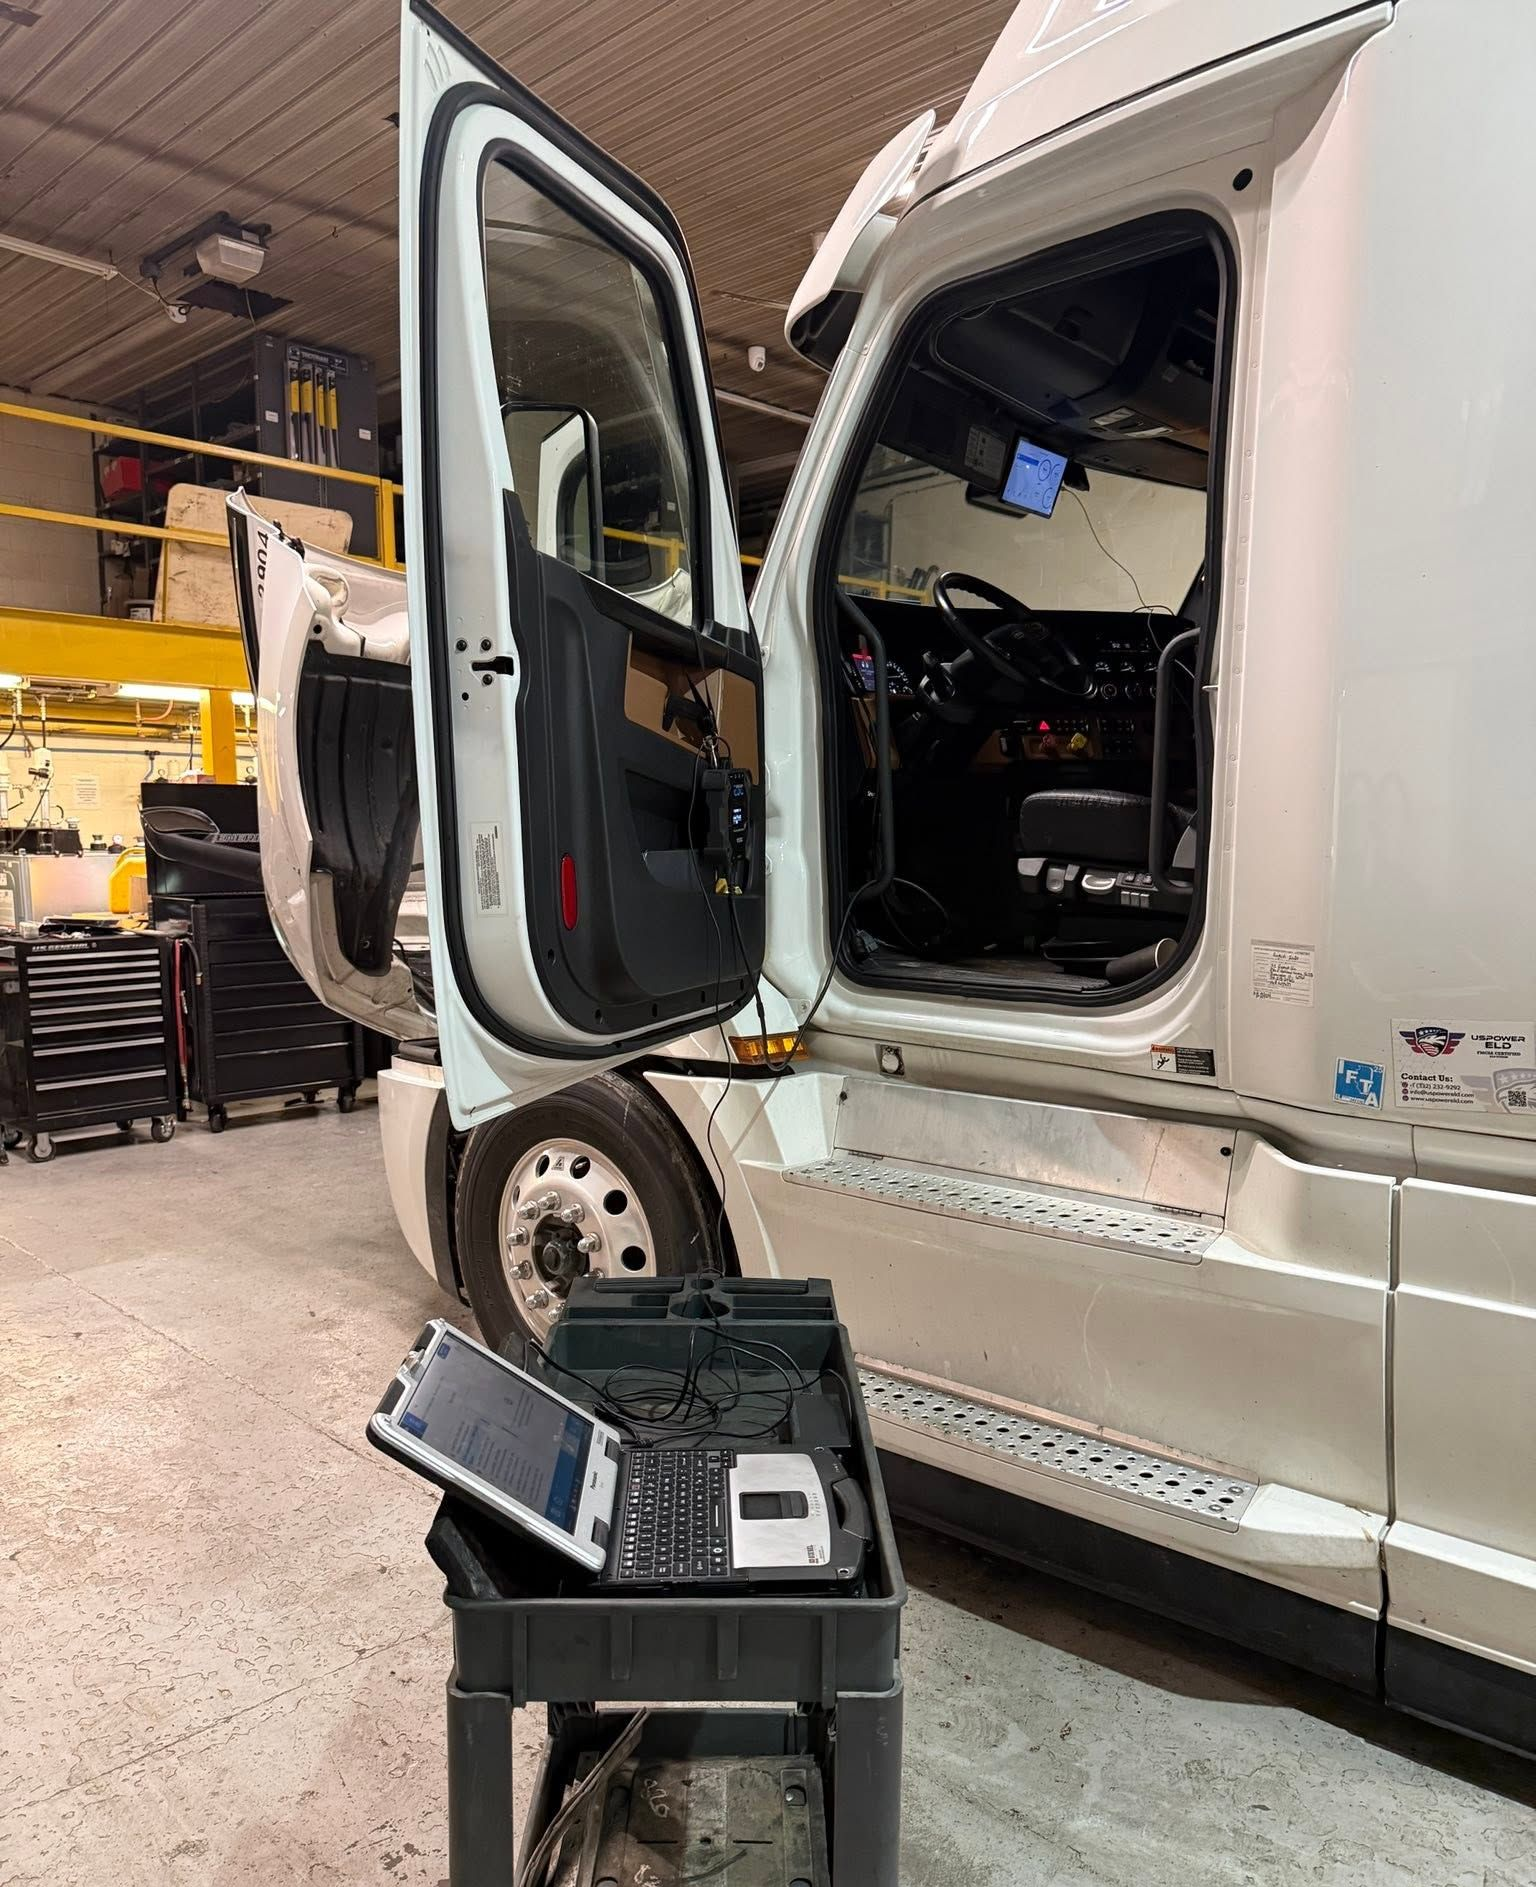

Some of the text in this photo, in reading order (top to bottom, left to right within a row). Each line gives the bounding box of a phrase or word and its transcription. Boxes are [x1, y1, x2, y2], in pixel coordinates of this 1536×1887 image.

[1471, 1034, 1526, 1042] USPOWER
[1485, 1041, 1512, 1049] ELD
[1401, 1073, 1436, 1081] Contact
